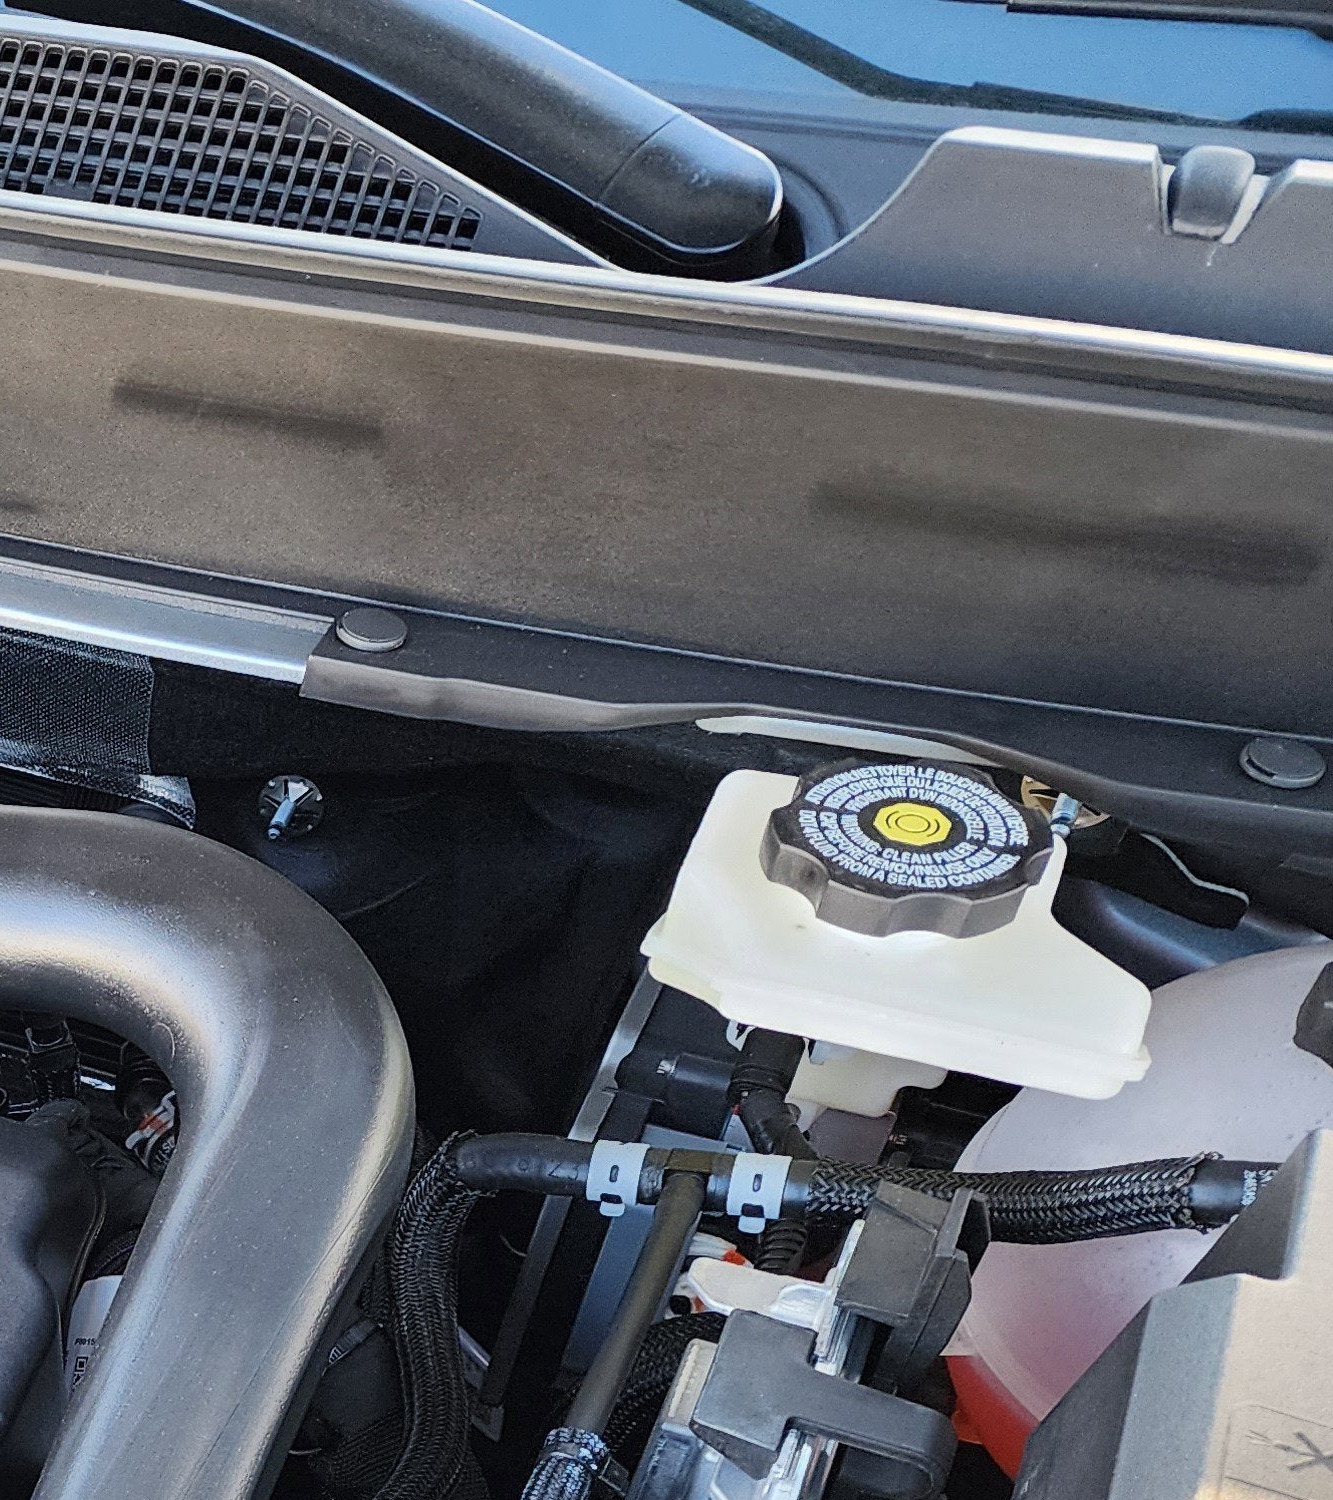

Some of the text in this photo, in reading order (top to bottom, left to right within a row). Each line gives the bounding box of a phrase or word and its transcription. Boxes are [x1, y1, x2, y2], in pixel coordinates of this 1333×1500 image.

[907, 777, 924, 787] DU
[917, 767, 935, 779] LE
[799, 810, 818, 827] DOT
[820, 811, 838, 830] CAP
[808, 832, 839, 857] FLUID
[824, 829, 868, 860] BEFORE
[882, 848, 933, 864] CLEAN
[933, 842, 978, 864] FILLER
[831, 853, 876, 878] FROM
[965, 847, 997, 868] ONLY
[873, 868, 886, 882] A
[941, 861, 972, 875] USE
[887, 872, 947, 888] SEALED
